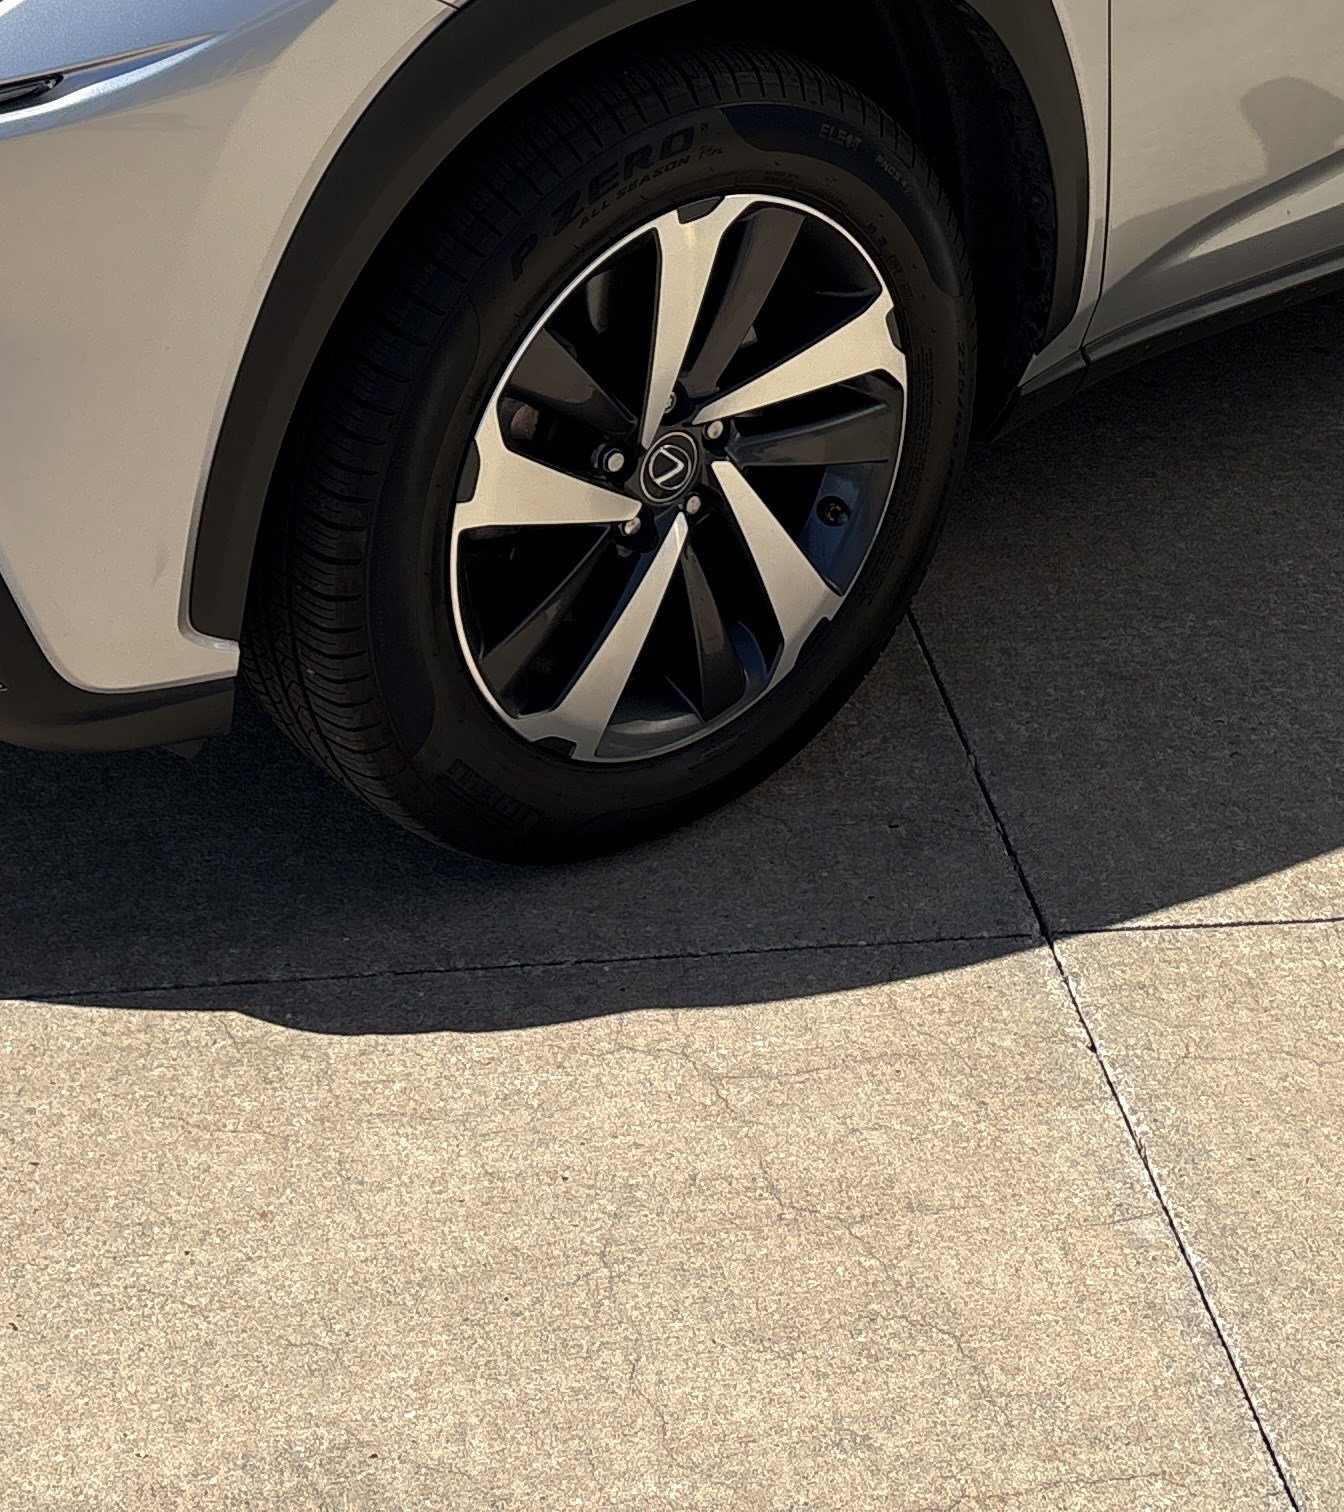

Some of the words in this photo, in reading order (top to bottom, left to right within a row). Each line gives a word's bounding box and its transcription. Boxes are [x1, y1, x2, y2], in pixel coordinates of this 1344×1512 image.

[552, 125, 696, 237] ZERO
[578, 200, 611, 230] ALL
[616, 154, 692, 201] SEASON
